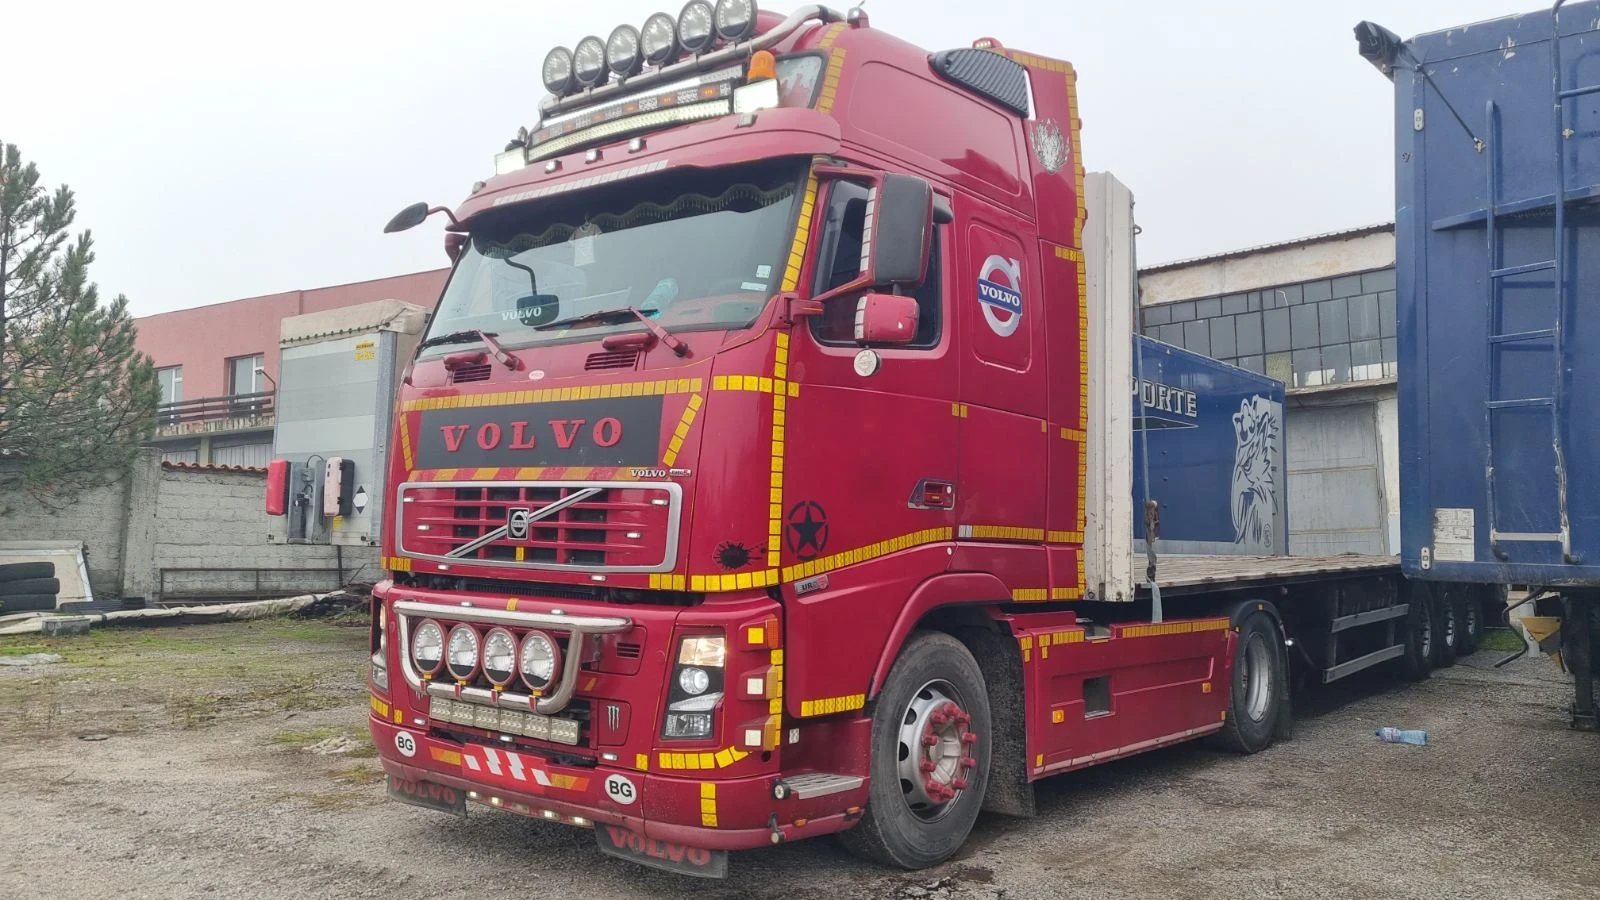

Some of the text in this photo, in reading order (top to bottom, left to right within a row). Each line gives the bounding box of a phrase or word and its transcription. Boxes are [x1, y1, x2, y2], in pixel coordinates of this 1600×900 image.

[979, 283, 1020, 307] VOLVO
[501, 306, 542, 321] VOLVO
[440, 417, 623, 452] VOLVO
[630, 469, 666, 477] VOLVO
[397, 735, 413, 751] BG
[609, 779, 633, 798] BG
[607, 826, 711, 866] VOLVO
